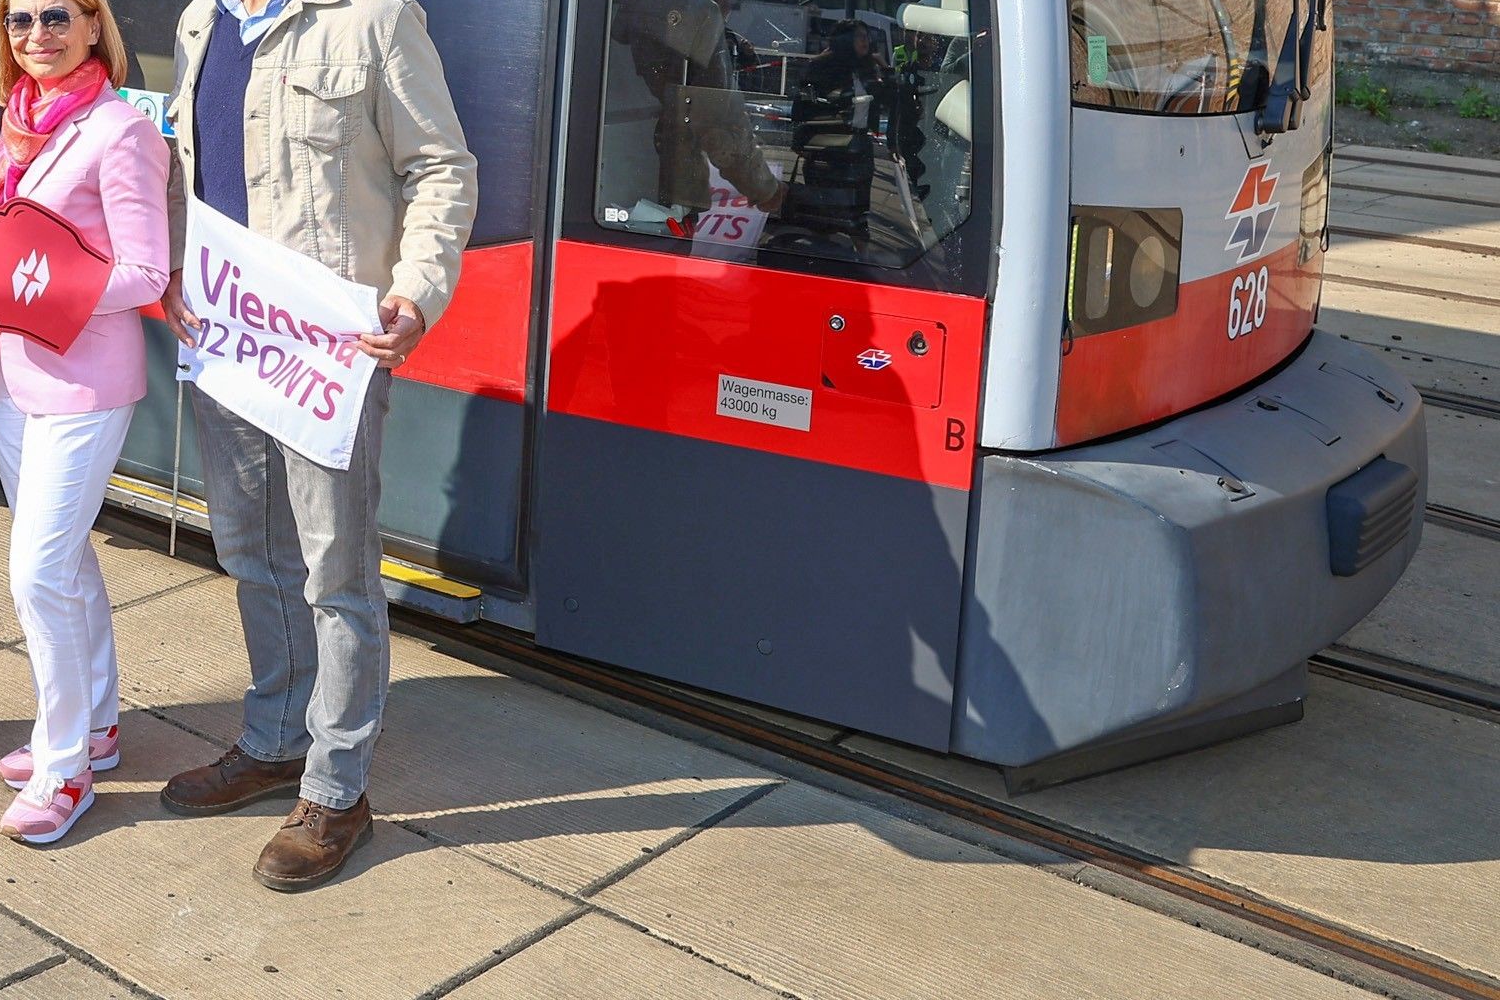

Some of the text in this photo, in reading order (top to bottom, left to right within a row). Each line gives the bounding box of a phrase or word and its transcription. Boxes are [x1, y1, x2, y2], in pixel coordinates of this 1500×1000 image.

[201, 246, 361, 370] Vienna
[1227, 265, 1269, 340] 628
[198, 317, 345, 421] 12 POINTS
[721, 378, 809, 407] Wagenmasse:
[720, 396, 778, 420] 43000 kg
[945, 417, 966, 452] B
